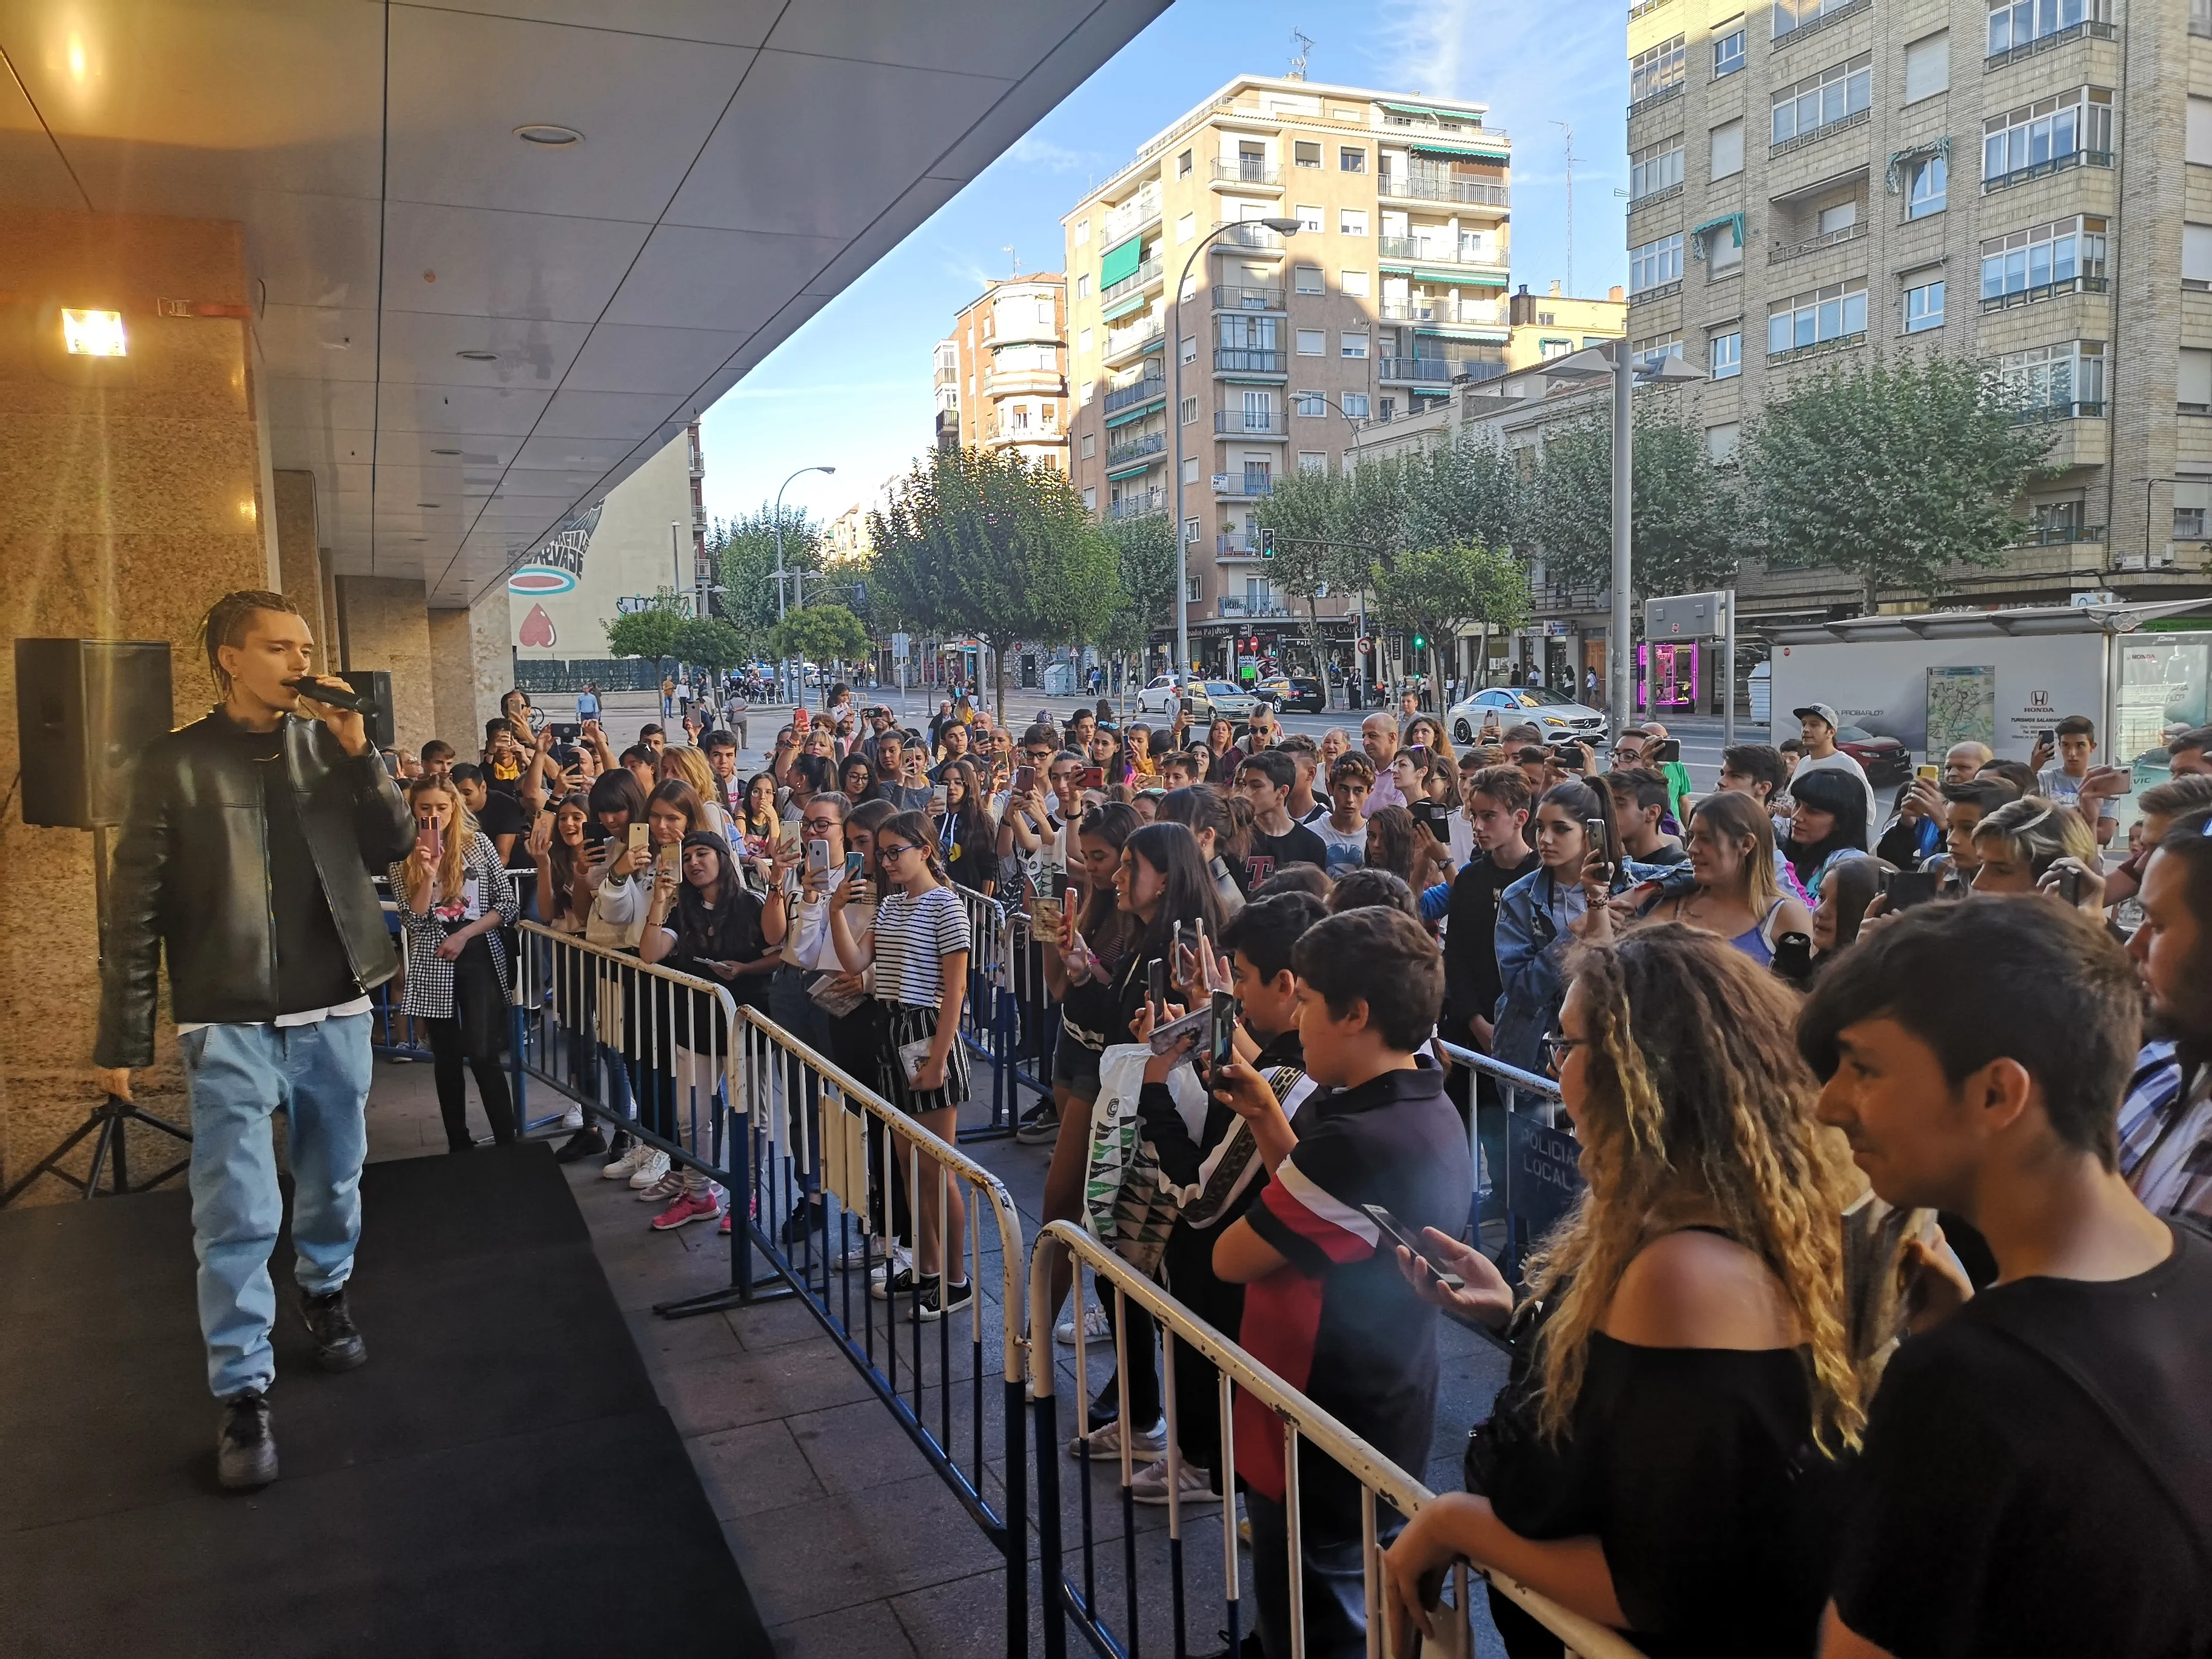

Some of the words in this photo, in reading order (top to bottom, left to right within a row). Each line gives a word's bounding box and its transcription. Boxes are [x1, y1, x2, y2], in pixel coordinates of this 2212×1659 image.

[525, 545, 584, 580] ALVAJE
[1245, 856, 1275, 891] T
[1523, 1153, 1572, 1191] LOCAL
